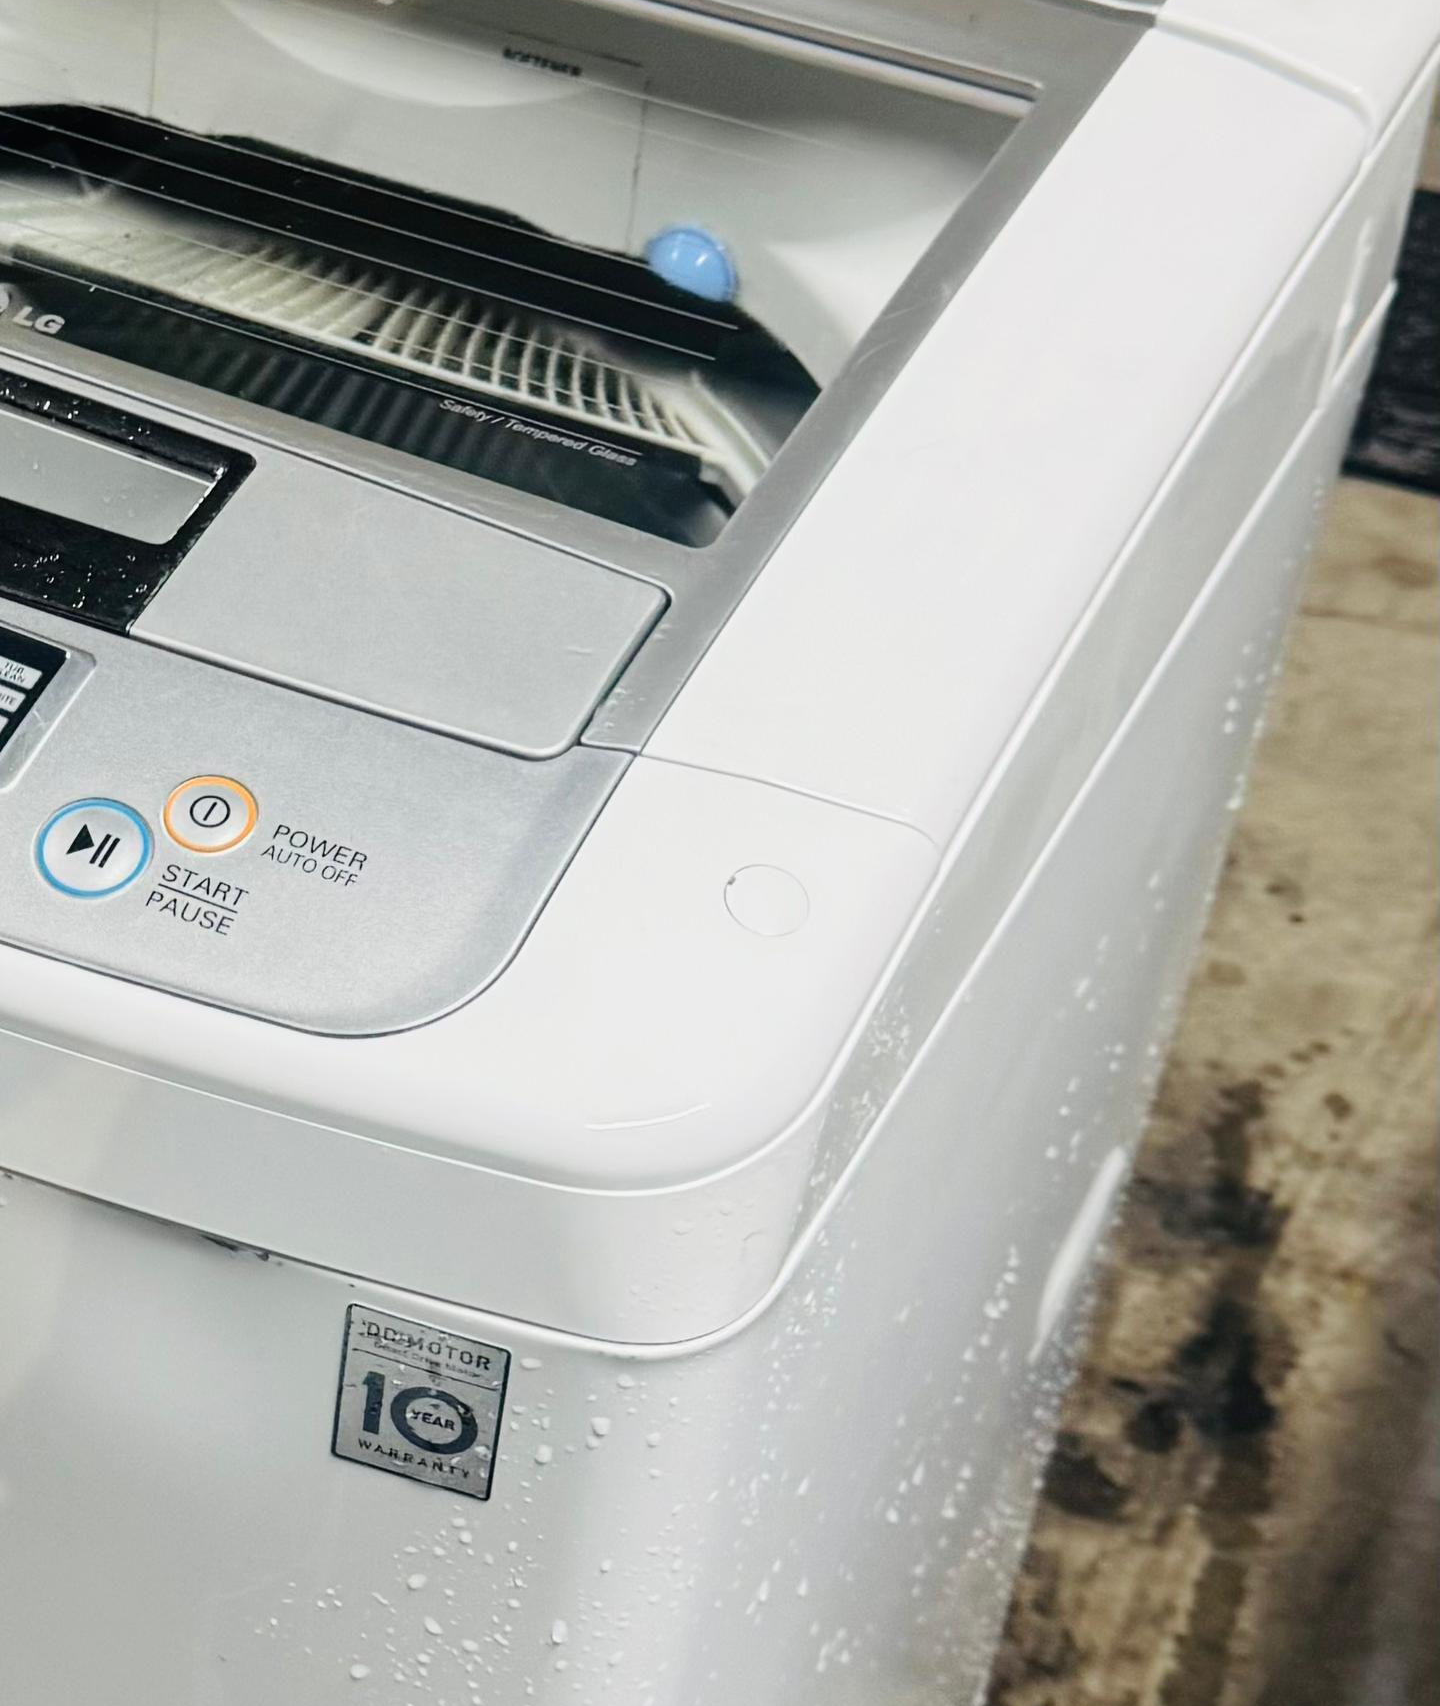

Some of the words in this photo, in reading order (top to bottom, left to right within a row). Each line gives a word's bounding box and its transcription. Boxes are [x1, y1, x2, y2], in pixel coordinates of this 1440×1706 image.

[12, 305, 65, 335] LG
[439, 399, 493, 422] Safety
[504, 418, 589, 451] Tempered
[588, 445, 638, 467] Glass
[261, 844, 318, 873] AUTO
[321, 865, 358, 887] OFF
[272, 824, 368, 871] POWER
[161, 864, 250, 907] START
[145, 890, 235, 936] PAUSE
[406, 1333, 491, 1371] MOTOR
[362, 1370, 479, 1455] 10
[411, 1409, 456, 1432] YEAR
[358, 1438, 470, 1478] WARRANTY
